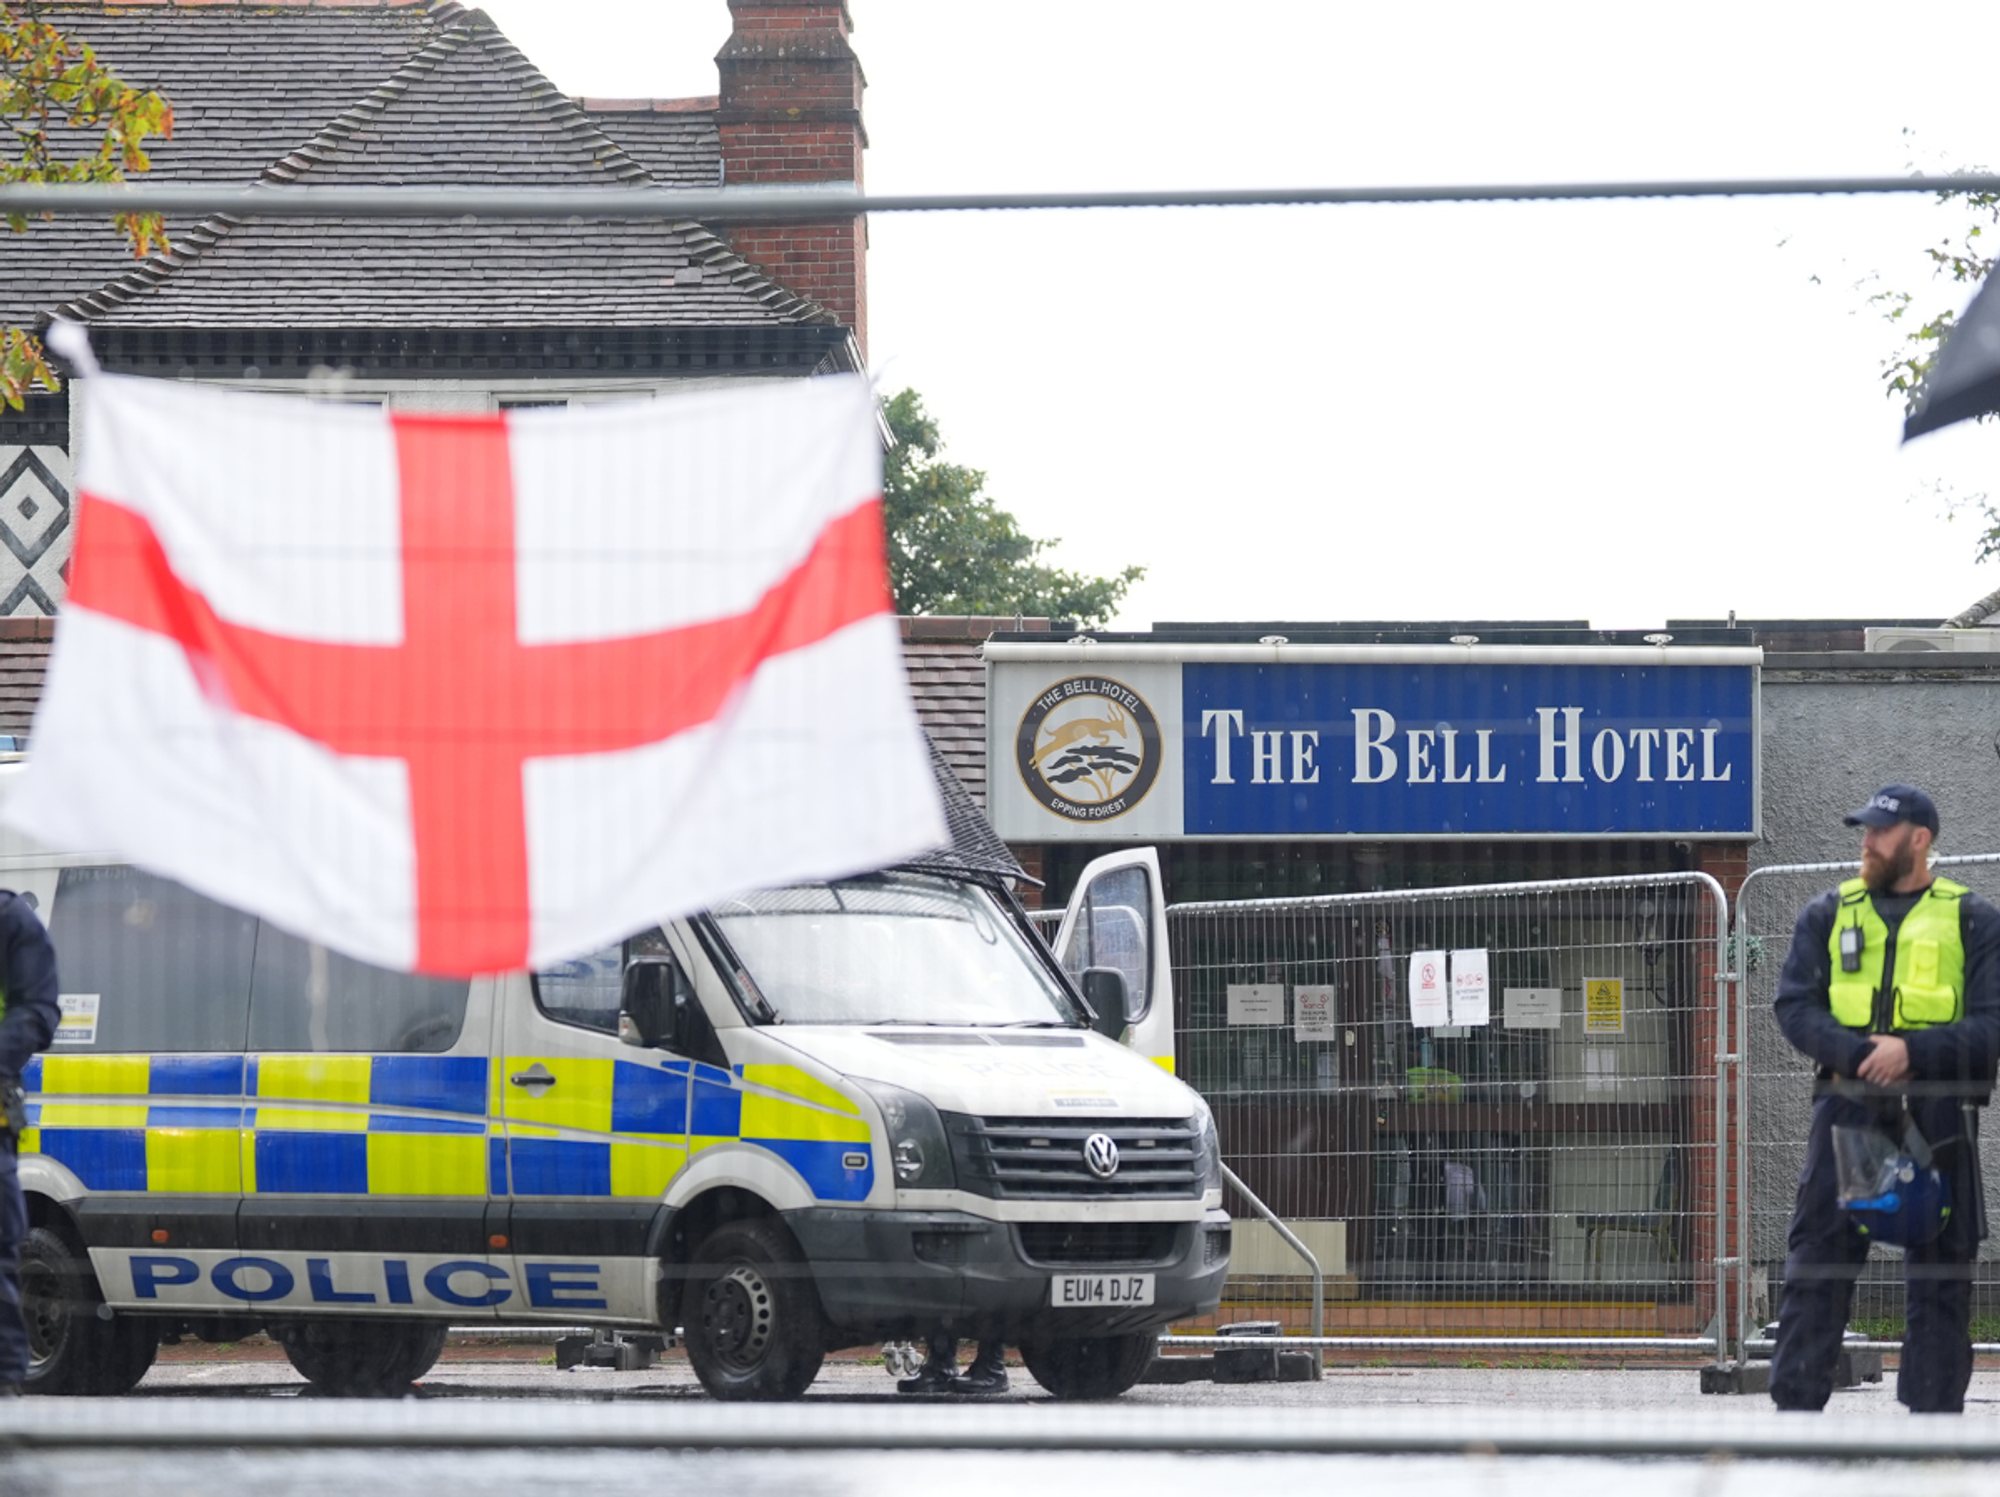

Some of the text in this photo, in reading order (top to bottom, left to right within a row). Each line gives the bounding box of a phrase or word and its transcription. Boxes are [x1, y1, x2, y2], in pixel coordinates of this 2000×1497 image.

[1037, 680, 1140, 713] THE BELL HOTEL
[1201, 706, 1732, 784] THE BELL HOTEL
[1050, 798, 1126, 817] EPPING FOREST
[962, 1061, 1127, 1080] POLICE
[128, 1255, 608, 1310] POLICE
[1063, 1277, 1144, 1302] EU14 DJZ
